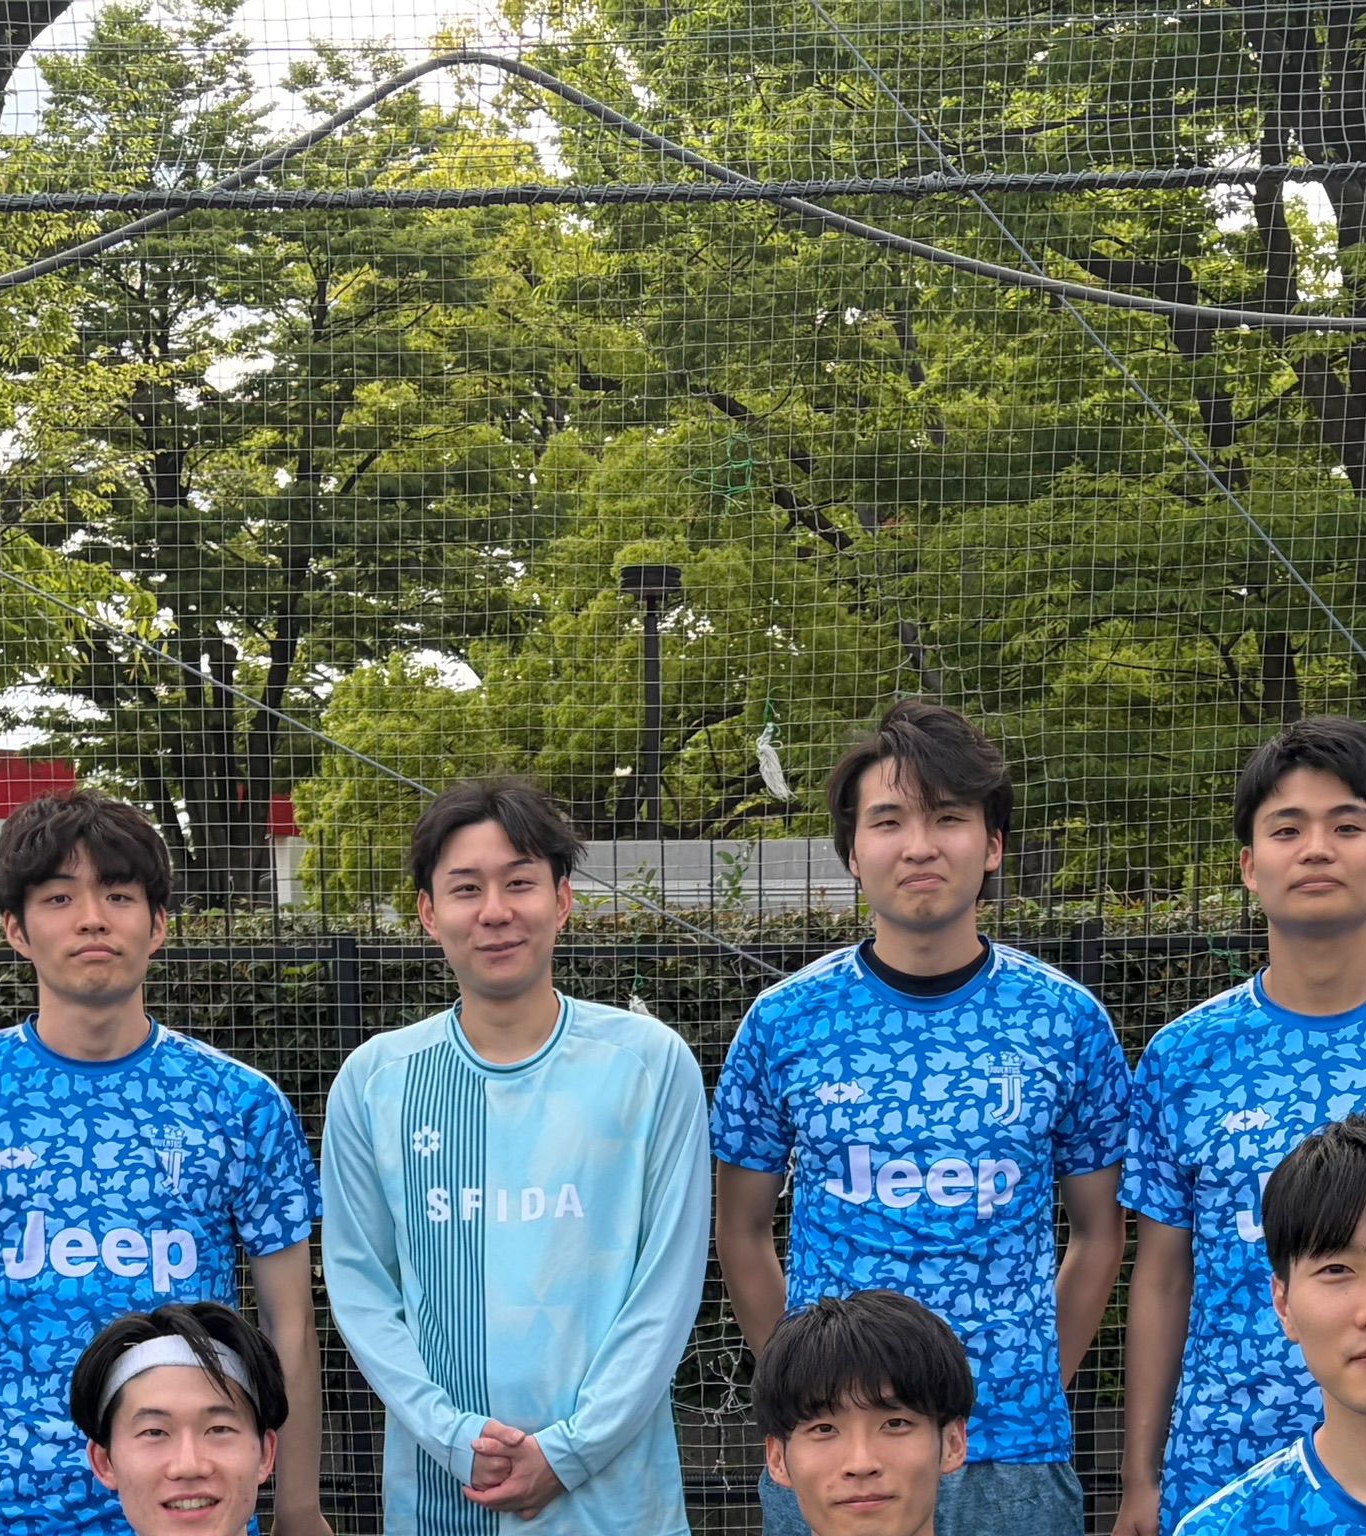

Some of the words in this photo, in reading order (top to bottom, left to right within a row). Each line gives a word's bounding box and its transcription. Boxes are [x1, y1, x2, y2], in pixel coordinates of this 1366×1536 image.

[426, 1184, 584, 1222] SFIDA
[824, 1144, 1022, 1220] Jeep
[2, 1210, 198, 1293] Jeep
